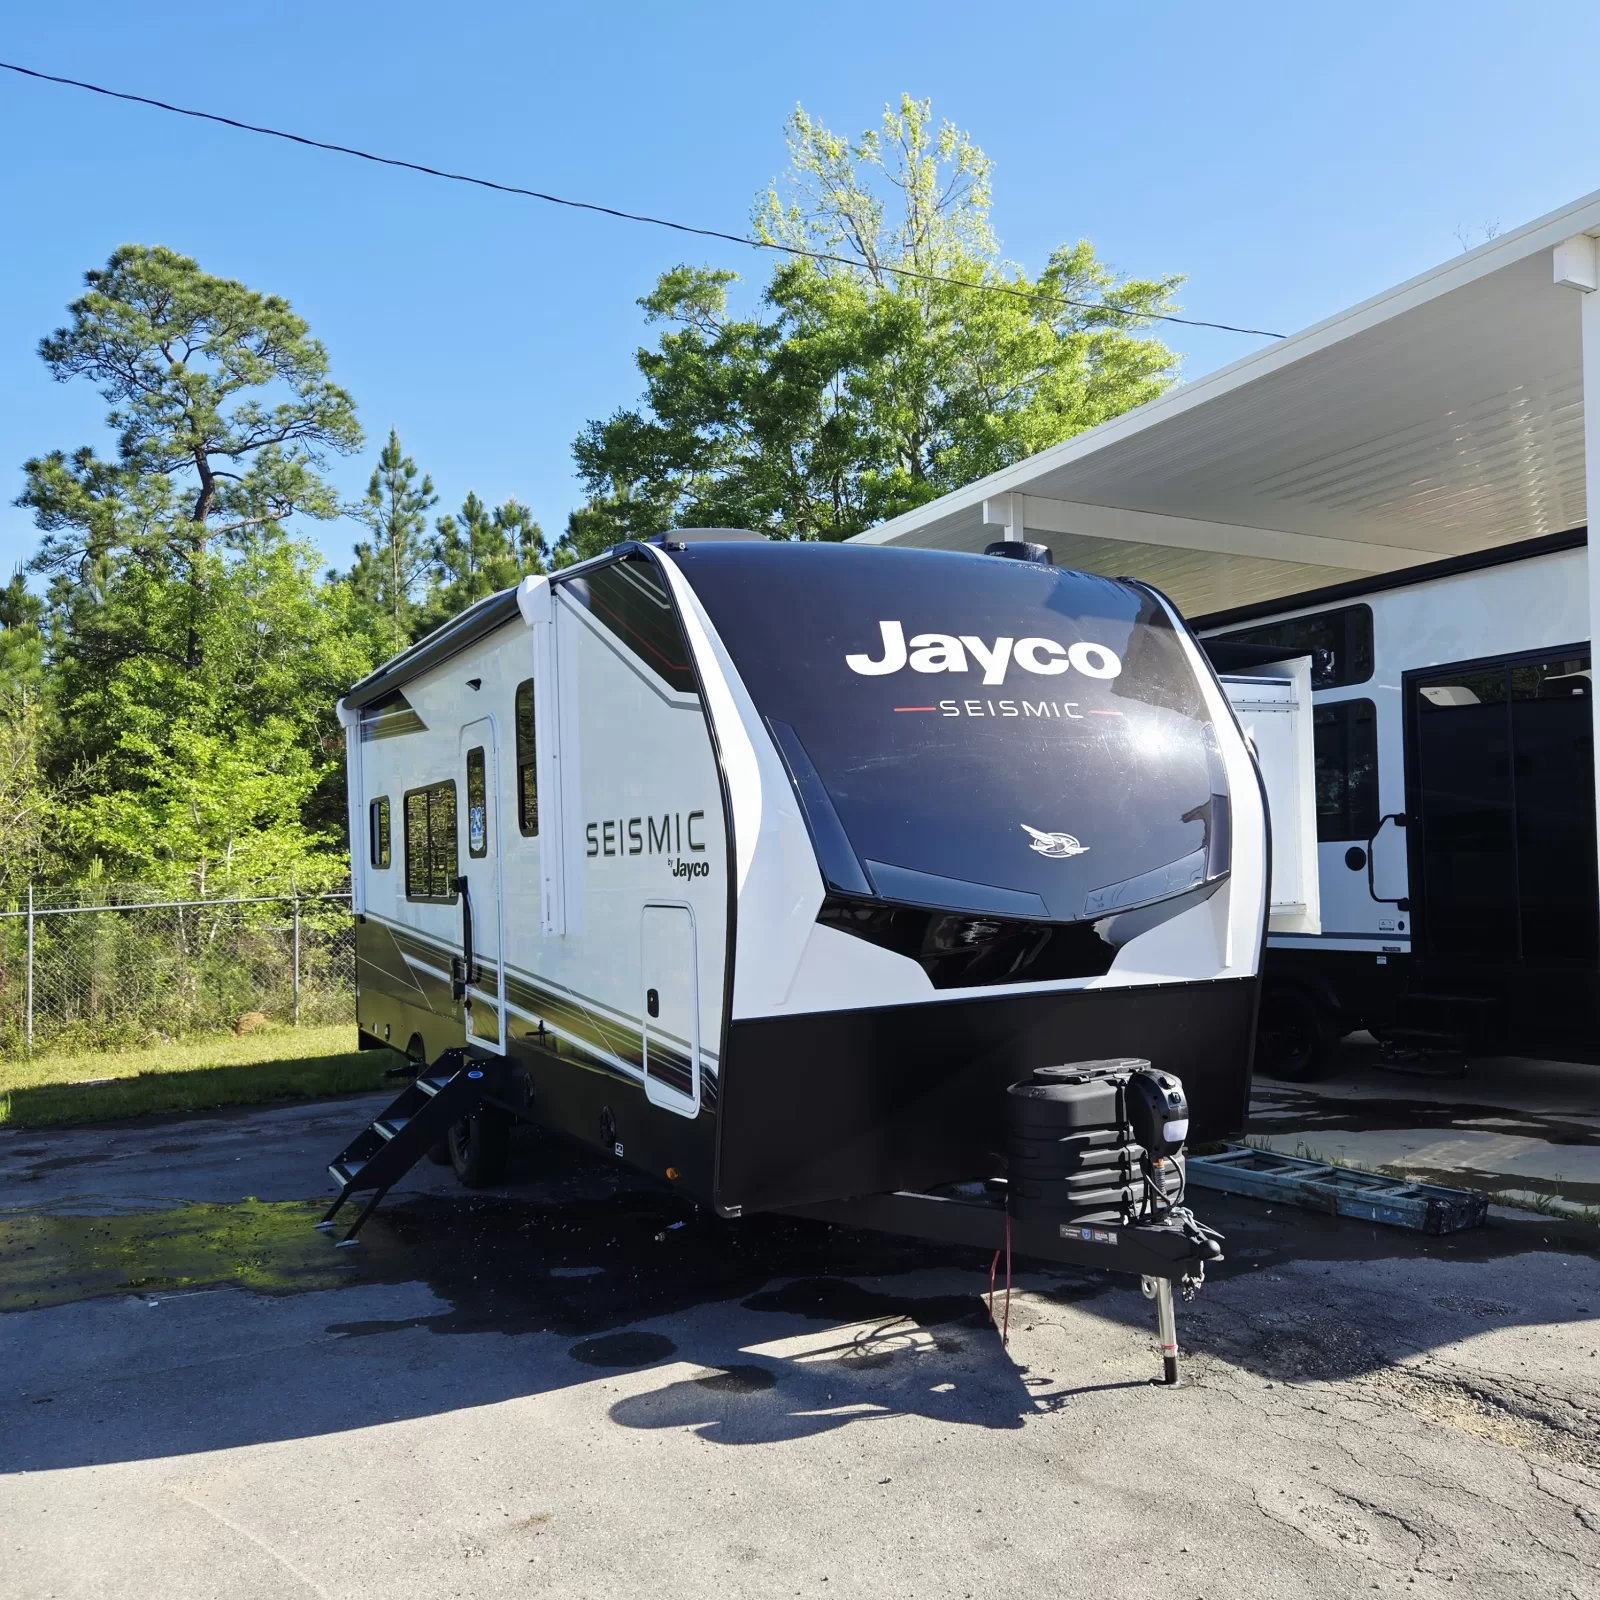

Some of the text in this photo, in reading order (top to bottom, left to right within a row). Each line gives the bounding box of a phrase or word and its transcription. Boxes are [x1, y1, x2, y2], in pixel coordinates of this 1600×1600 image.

[845, 621, 1122, 685] Jayco
[939, 700, 1084, 718] SEISMIC
[586, 810, 706, 857] SEISMIC
[667, 858, 709, 881] by Jayco
